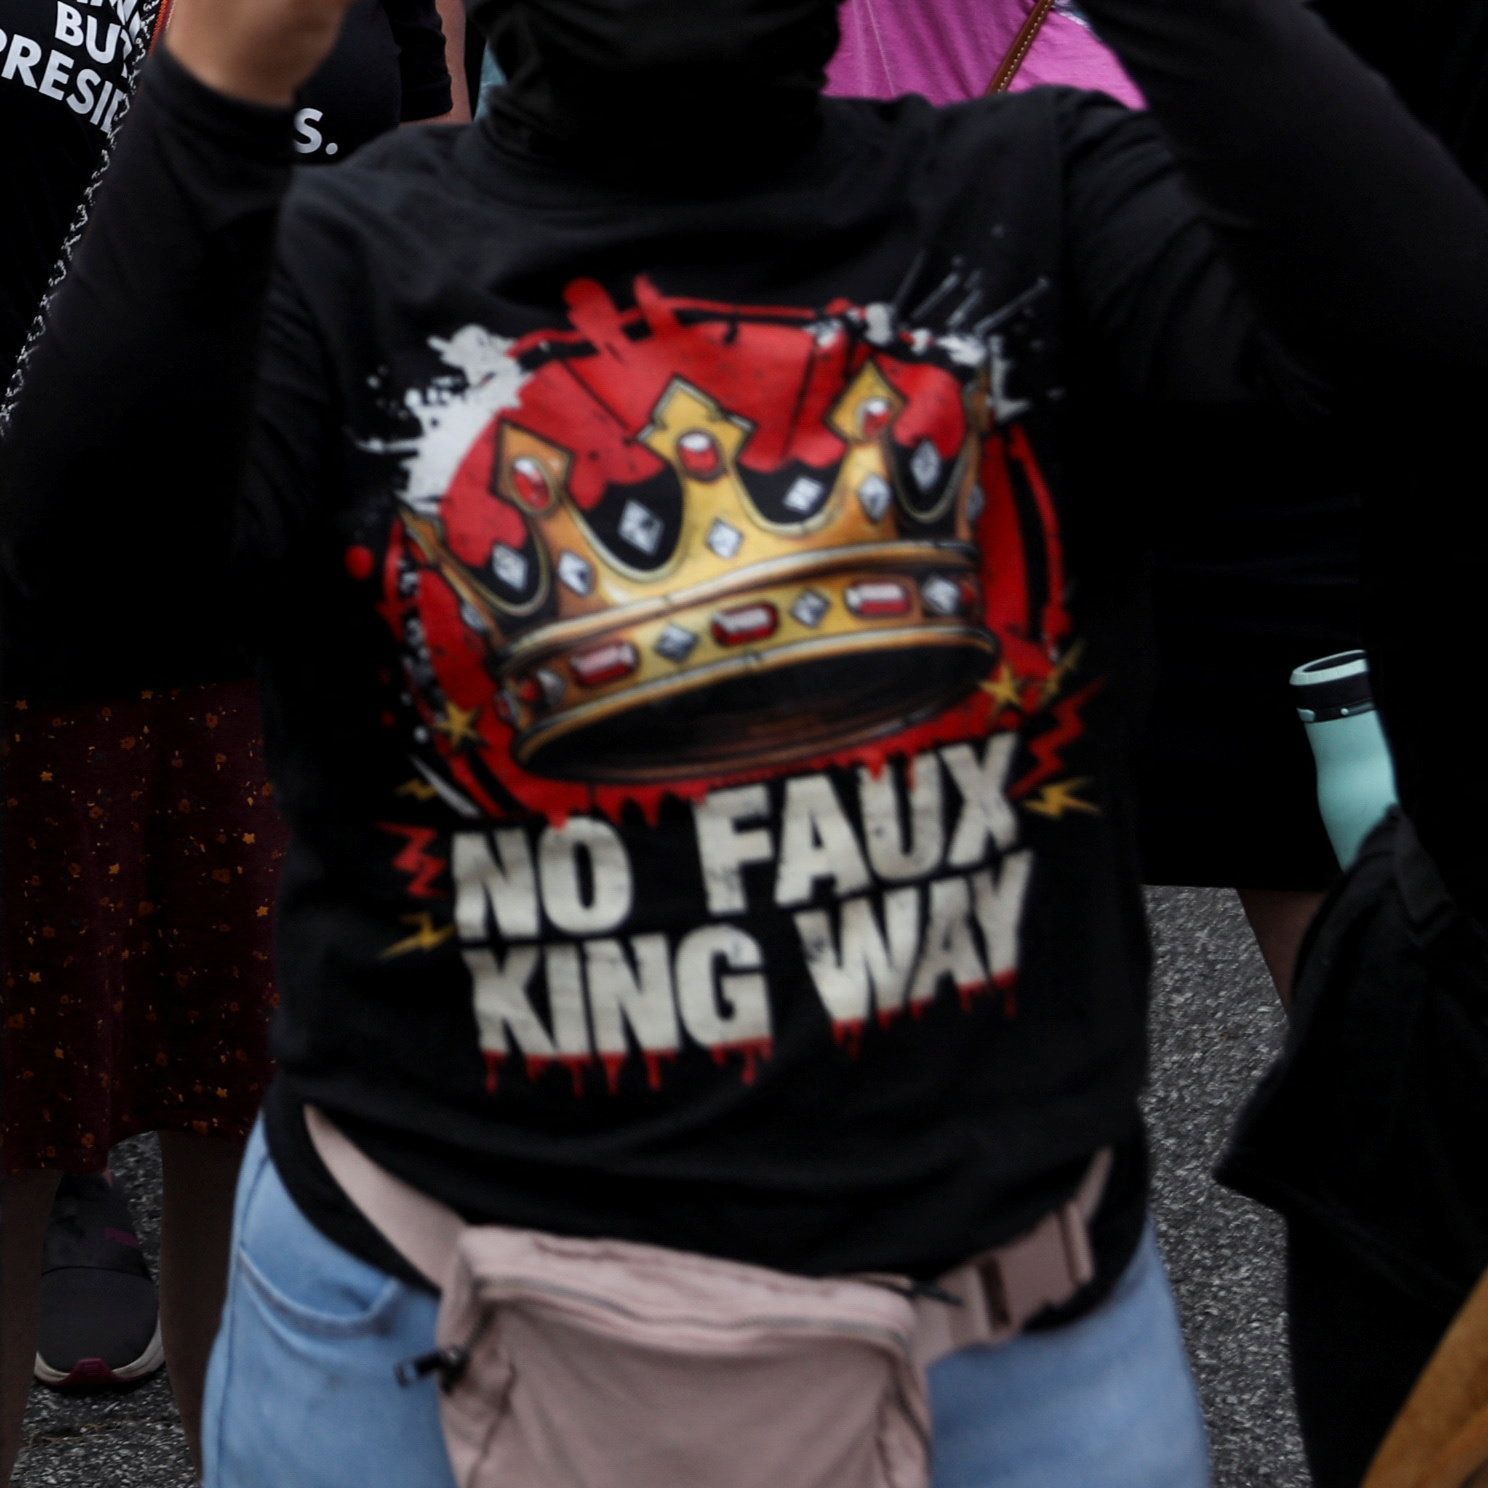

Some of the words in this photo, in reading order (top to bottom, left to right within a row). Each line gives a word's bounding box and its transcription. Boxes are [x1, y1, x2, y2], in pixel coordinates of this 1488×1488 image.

[451, 818, 633, 939] NO
[692, 732, 1020, 913] FAUX
[460, 924, 774, 1058] KING
[794, 851, 1034, 1024] WAY
